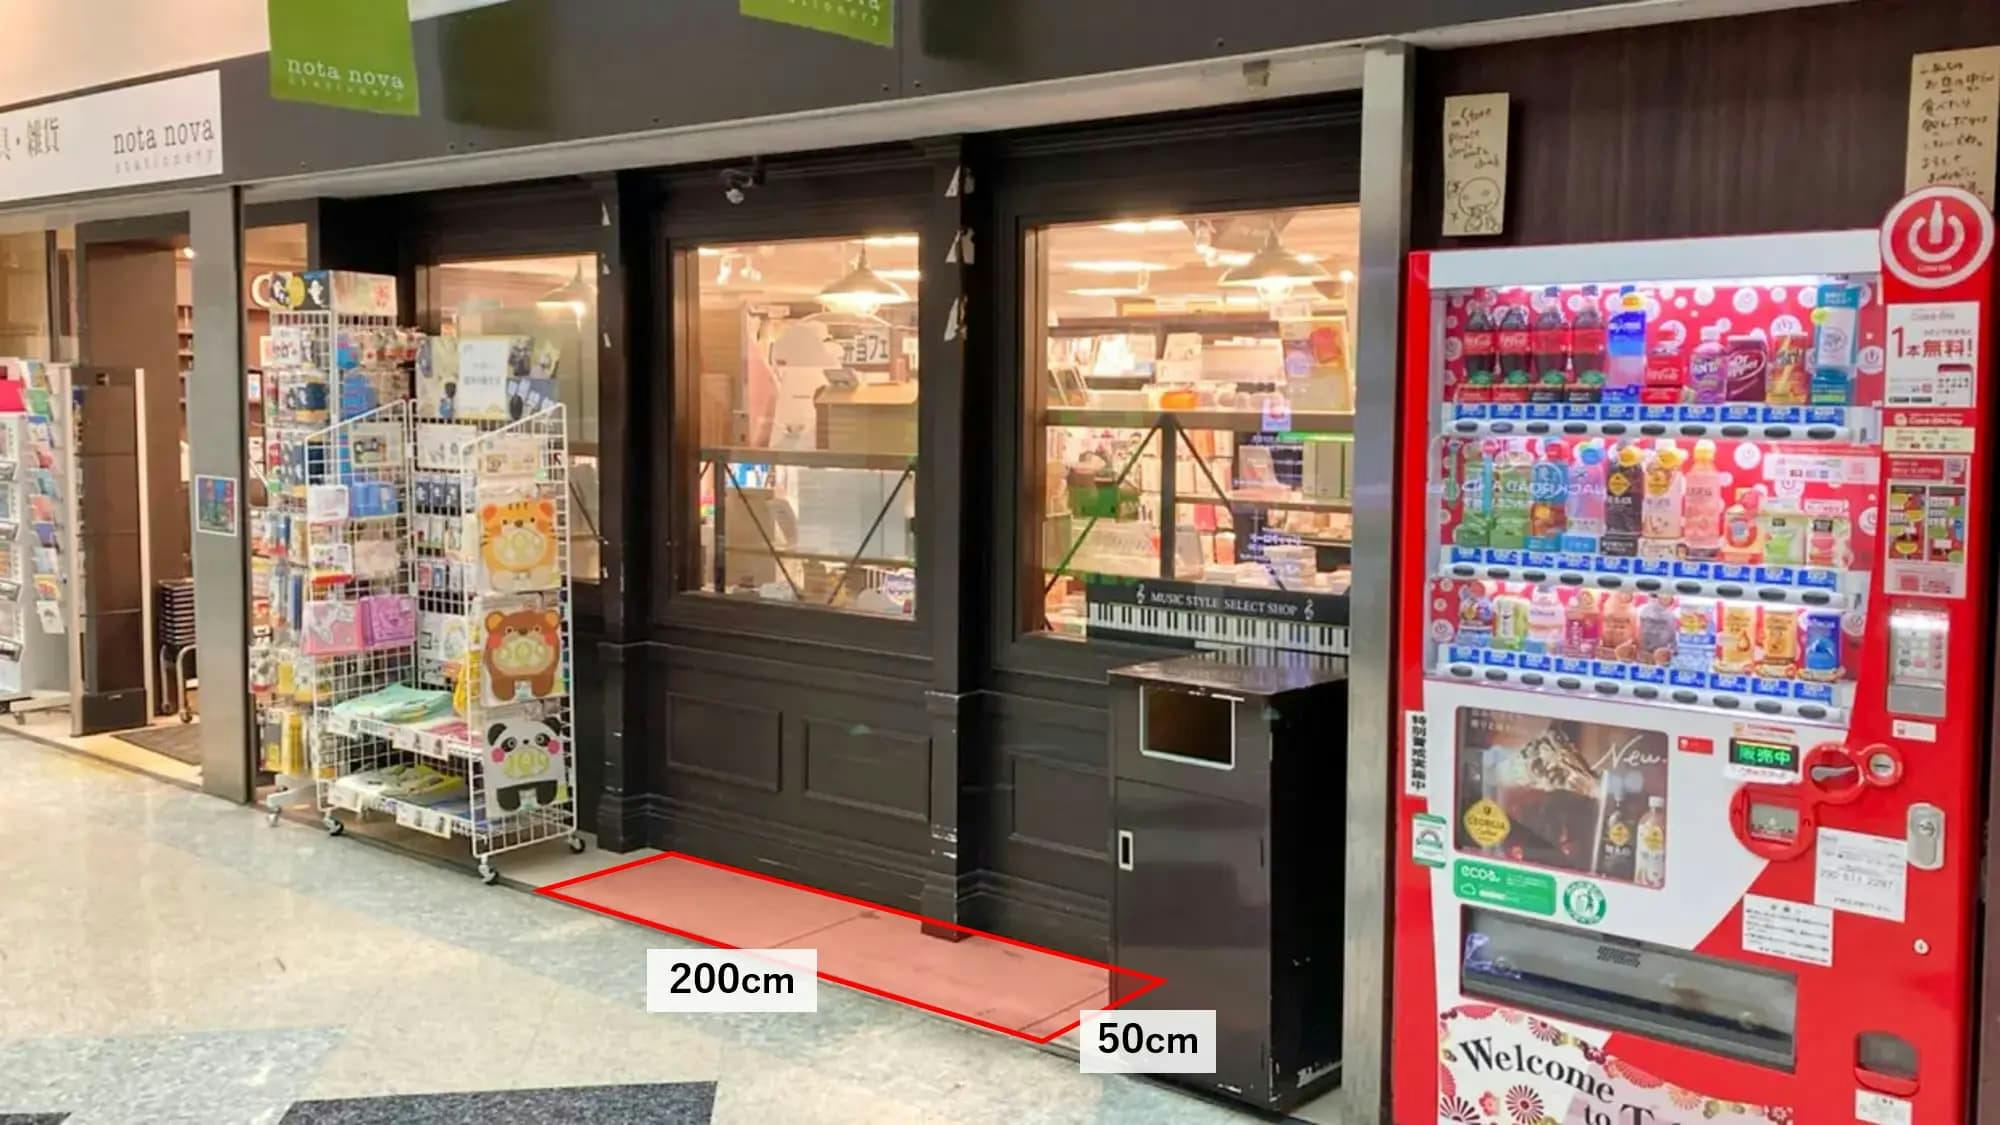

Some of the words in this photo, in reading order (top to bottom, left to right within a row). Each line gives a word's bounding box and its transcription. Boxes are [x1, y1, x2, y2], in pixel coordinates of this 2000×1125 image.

[287, 58, 341, 80] nota
[349, 69, 404, 90] nova
[114, 126, 157, 154] nota
[165, 118, 214, 146] nova
[1151, 591, 1184, 606] MUSIC
[1186, 594, 1218, 609] STYLE
[1224, 598, 1265, 613] SELECT
[1268, 601, 1298, 616] SHOP
[1459, 1036, 1615, 1104] Welcome
